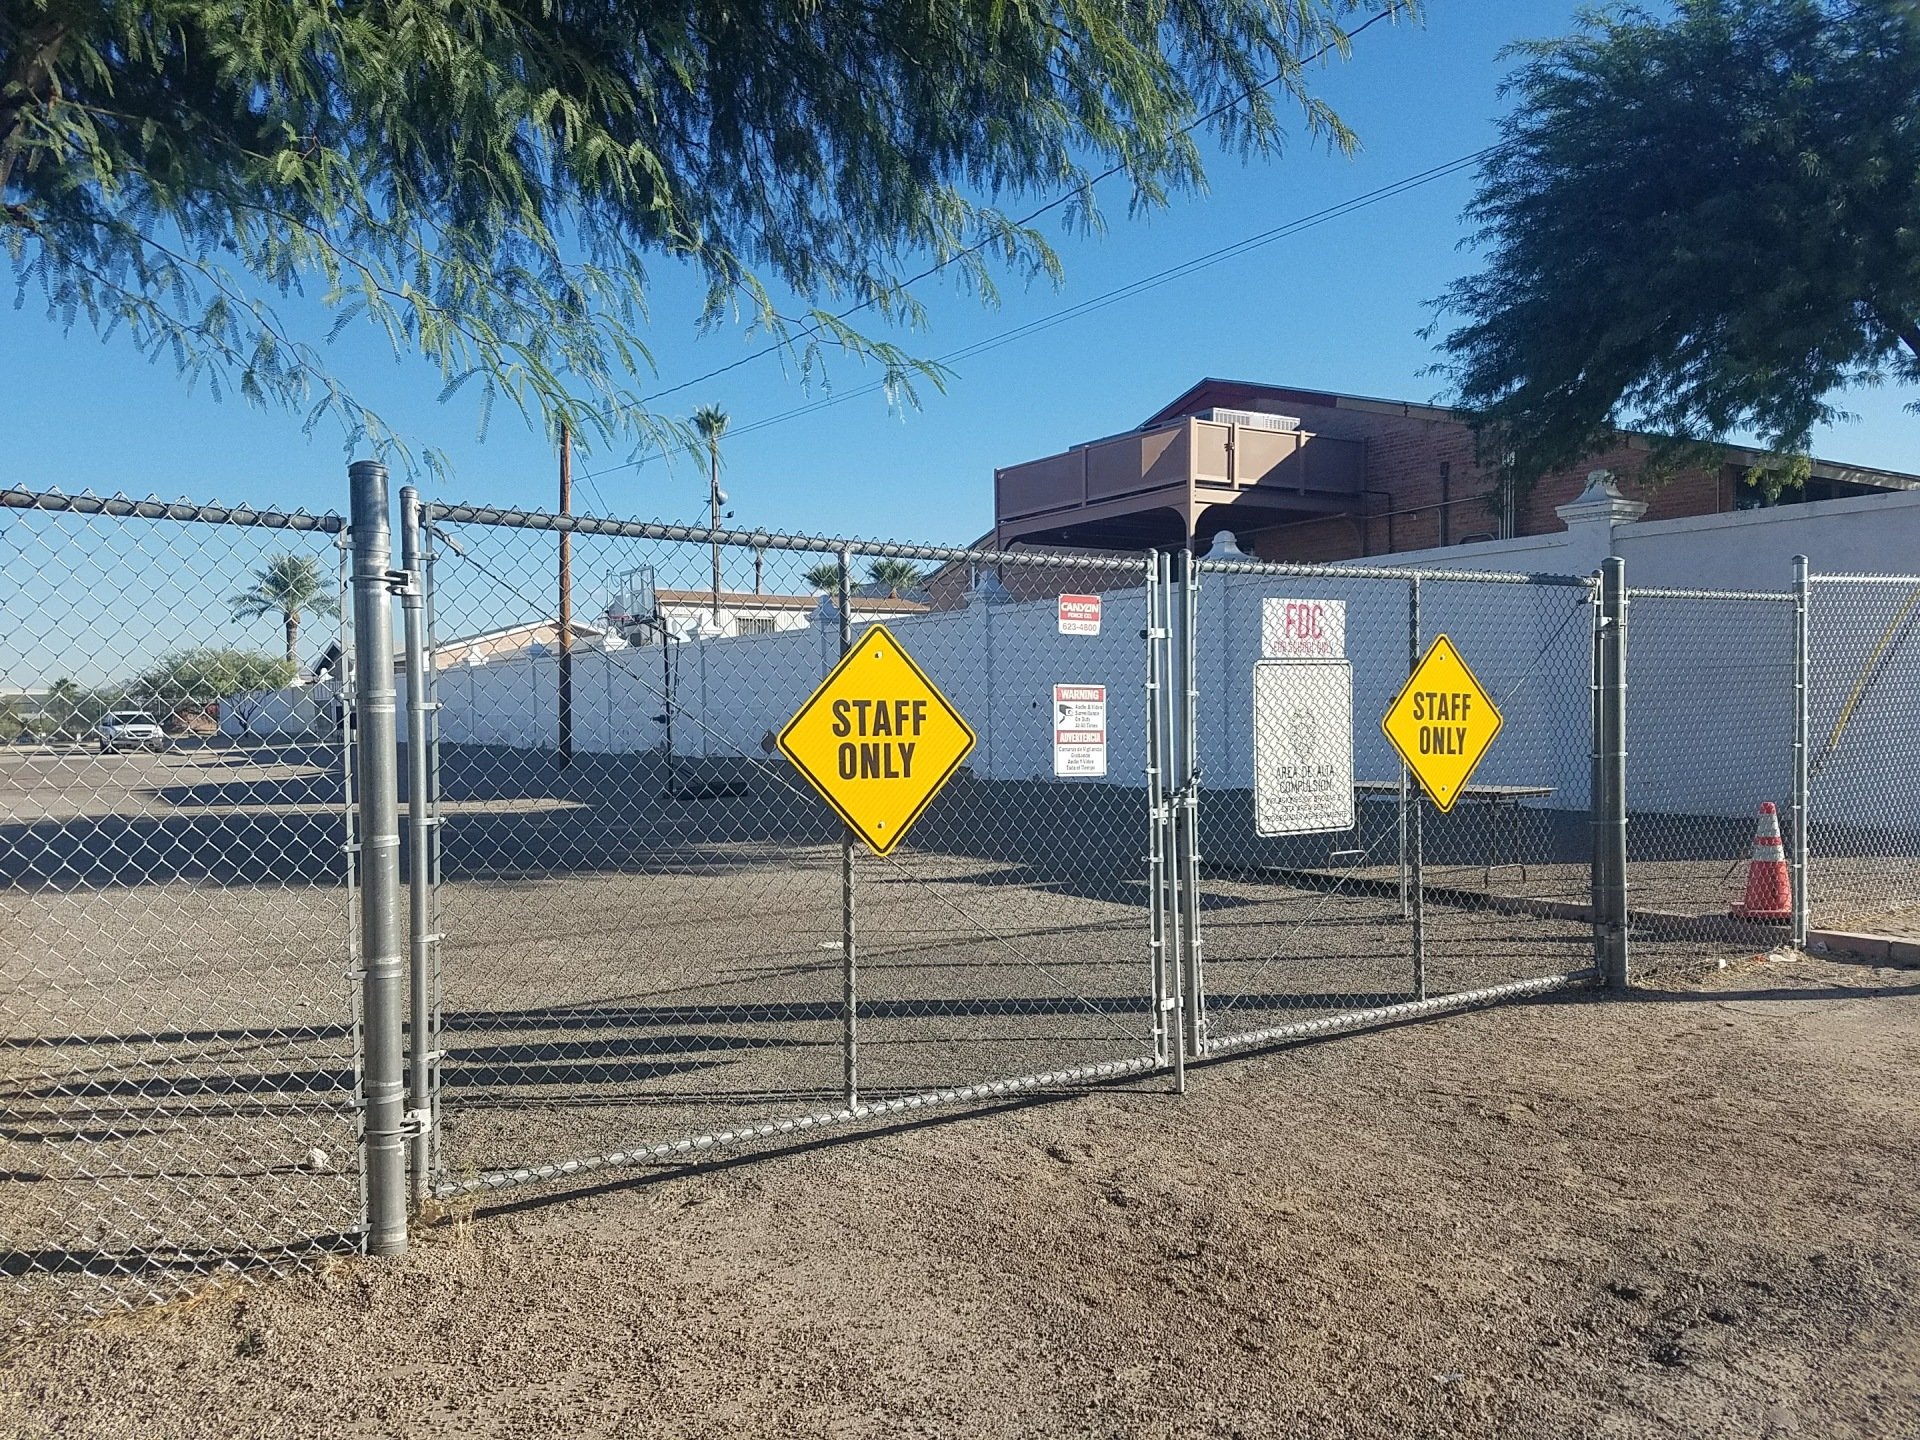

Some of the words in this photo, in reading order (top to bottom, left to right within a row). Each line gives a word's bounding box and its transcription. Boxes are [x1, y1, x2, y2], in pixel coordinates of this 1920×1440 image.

[1062, 622, 1097, 632] 623-4800
[1286, 603, 1323, 639] FDC
[1061, 689, 1099, 700] WARNING
[1413, 691, 1472, 721] STAFF
[832, 699, 928, 737] STAFF
[1059, 732, 1101, 743] ADVERTENCIA
[1420, 725, 1467, 755] ONLY
[838, 742, 916, 780] ONLY
[1302, 766, 1312, 778] DE
[1317, 765, 1334, 778] ALTA
